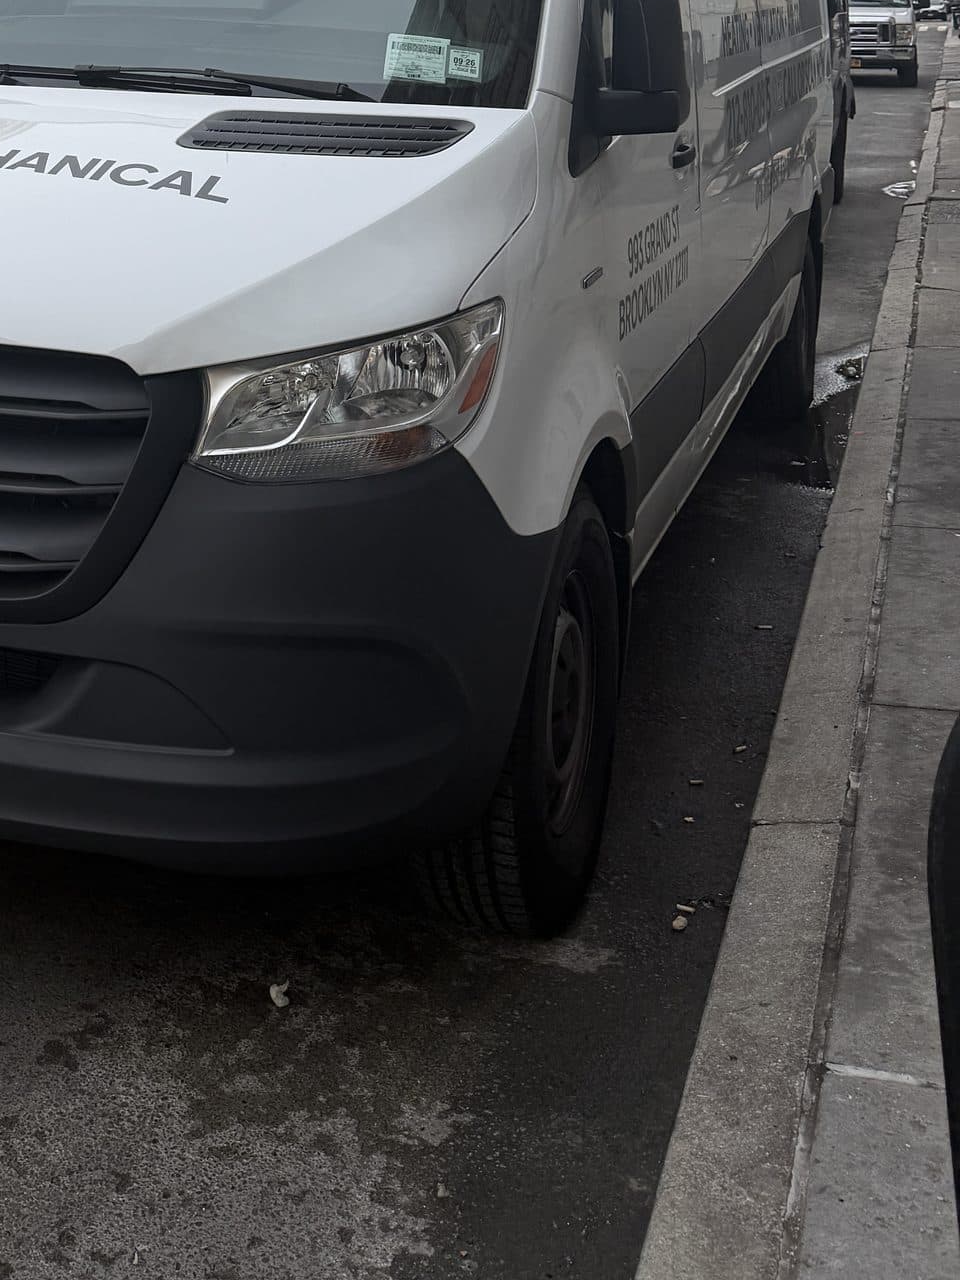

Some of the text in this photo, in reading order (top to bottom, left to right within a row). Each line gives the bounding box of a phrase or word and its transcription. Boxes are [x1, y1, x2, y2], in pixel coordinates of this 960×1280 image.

[453, 56, 464, 65] 09
[627, 204, 680, 278] 993 GRAND ST
[619, 265, 663, 342] BROOKLYN
[663, 256, 675, 301] NY
